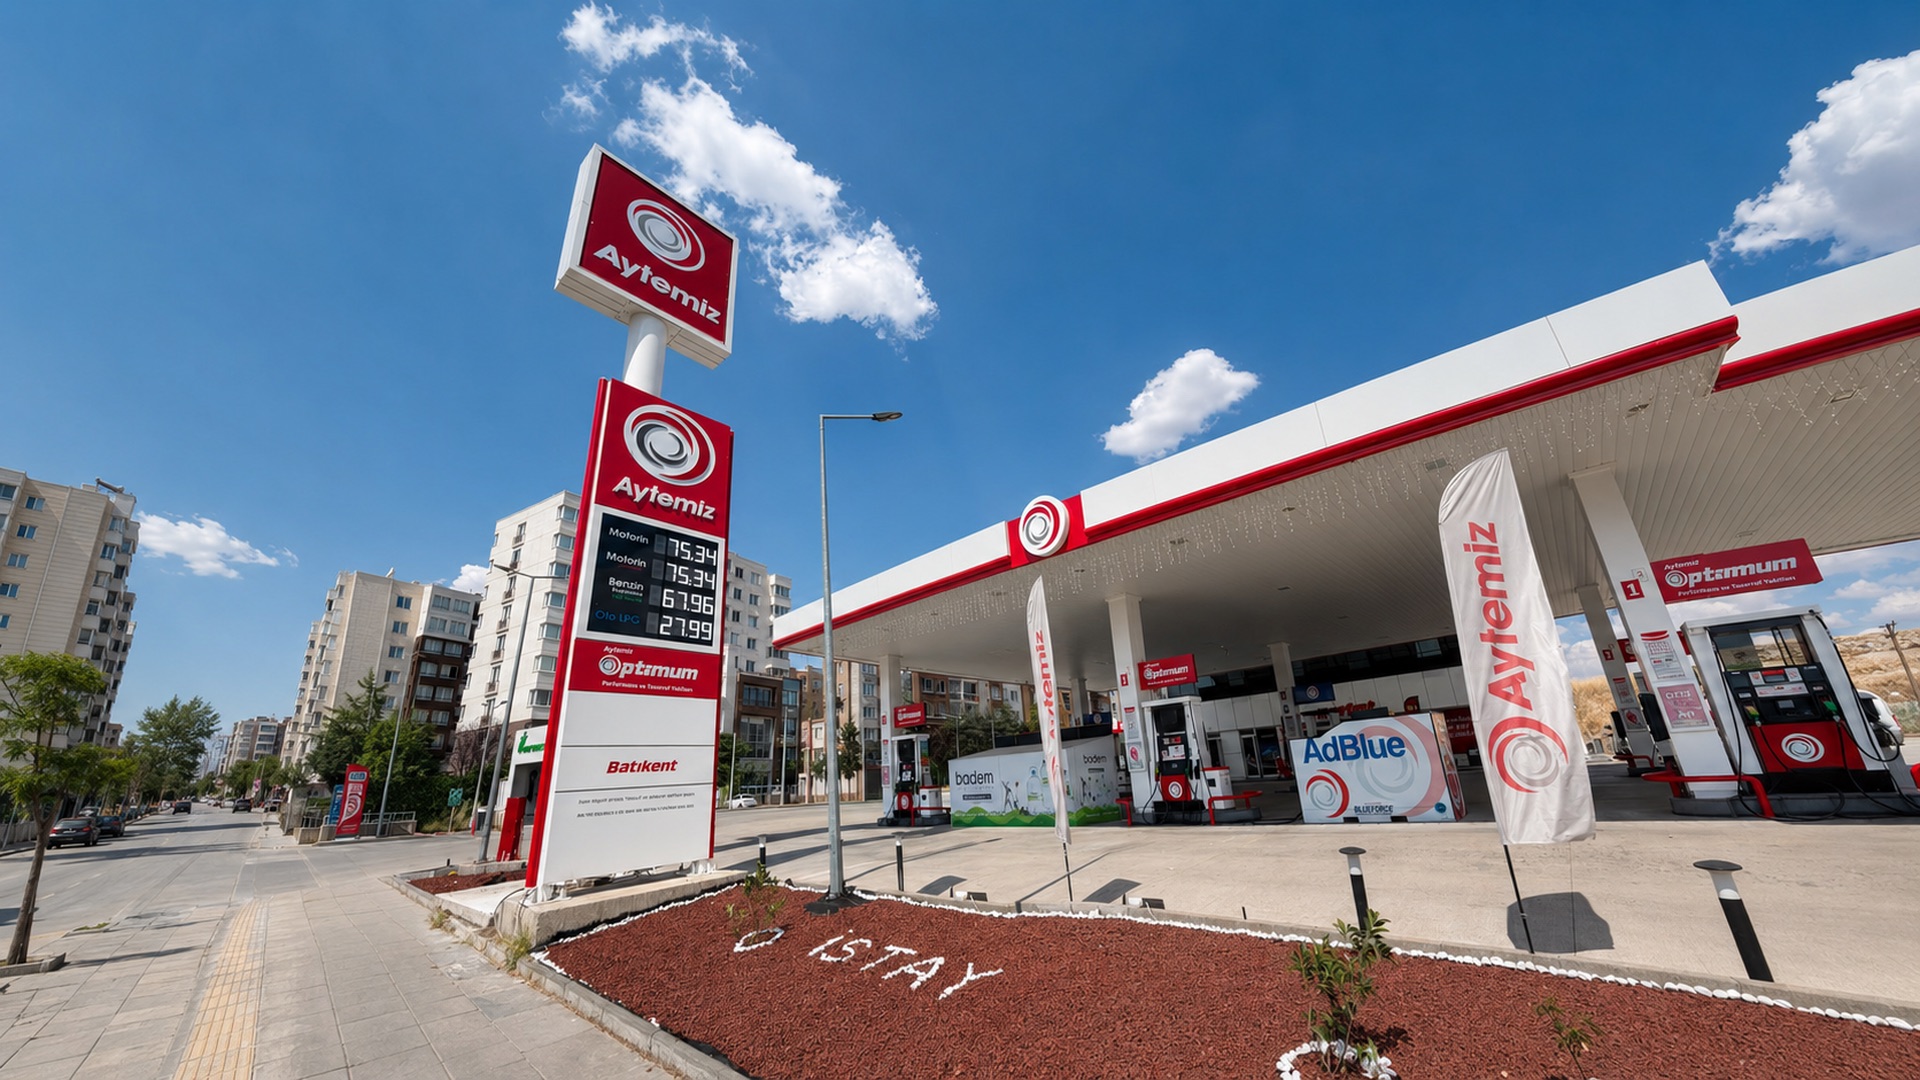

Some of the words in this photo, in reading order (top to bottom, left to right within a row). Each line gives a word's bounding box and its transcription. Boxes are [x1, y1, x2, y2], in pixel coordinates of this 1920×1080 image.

[593, 244, 722, 325] Aytemiz
[612, 476, 716, 520] Aytemiz
[609, 527, 649, 545] Motorin
[606, 551, 647, 568] Motorin
[1665, 556, 1797, 588] Optimum
[608, 577, 644, 591] Benzin
[1626, 583, 1641, 597] 1
[595, 609, 616, 622] Oto
[619, 614, 641, 625] LPG
[1463, 521, 1535, 711] Aytemiz
[598, 654, 699, 681] Optimum
[1303, 733, 1406, 764] AdBlue
[606, 759, 678, 774] Batıkent
[1083, 754, 1108, 764] badem
[955, 770, 994, 786] badem
